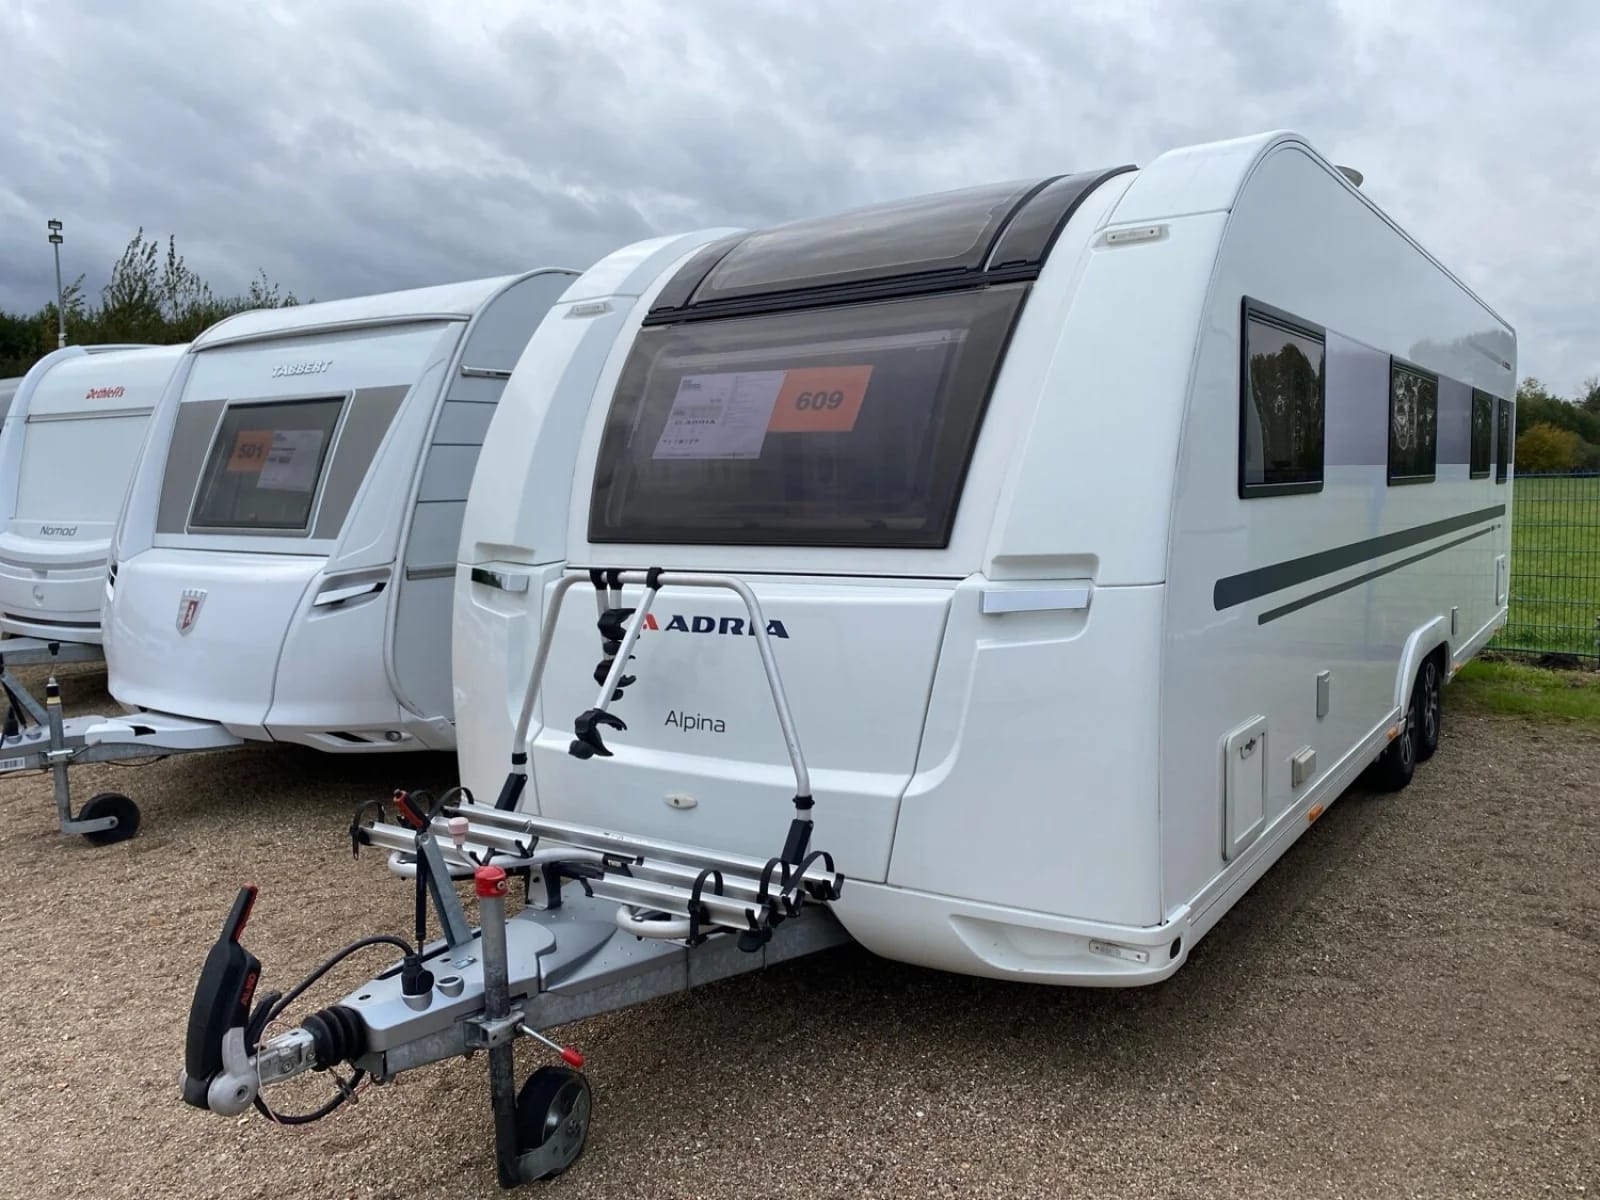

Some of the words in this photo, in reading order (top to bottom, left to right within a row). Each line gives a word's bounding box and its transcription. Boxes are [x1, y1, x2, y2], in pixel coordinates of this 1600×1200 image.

[272, 360, 334, 378] TABBERT
[795, 390, 845, 411] 609
[40, 525, 78, 536] Nomad
[664, 710, 726, 733] Alpina
